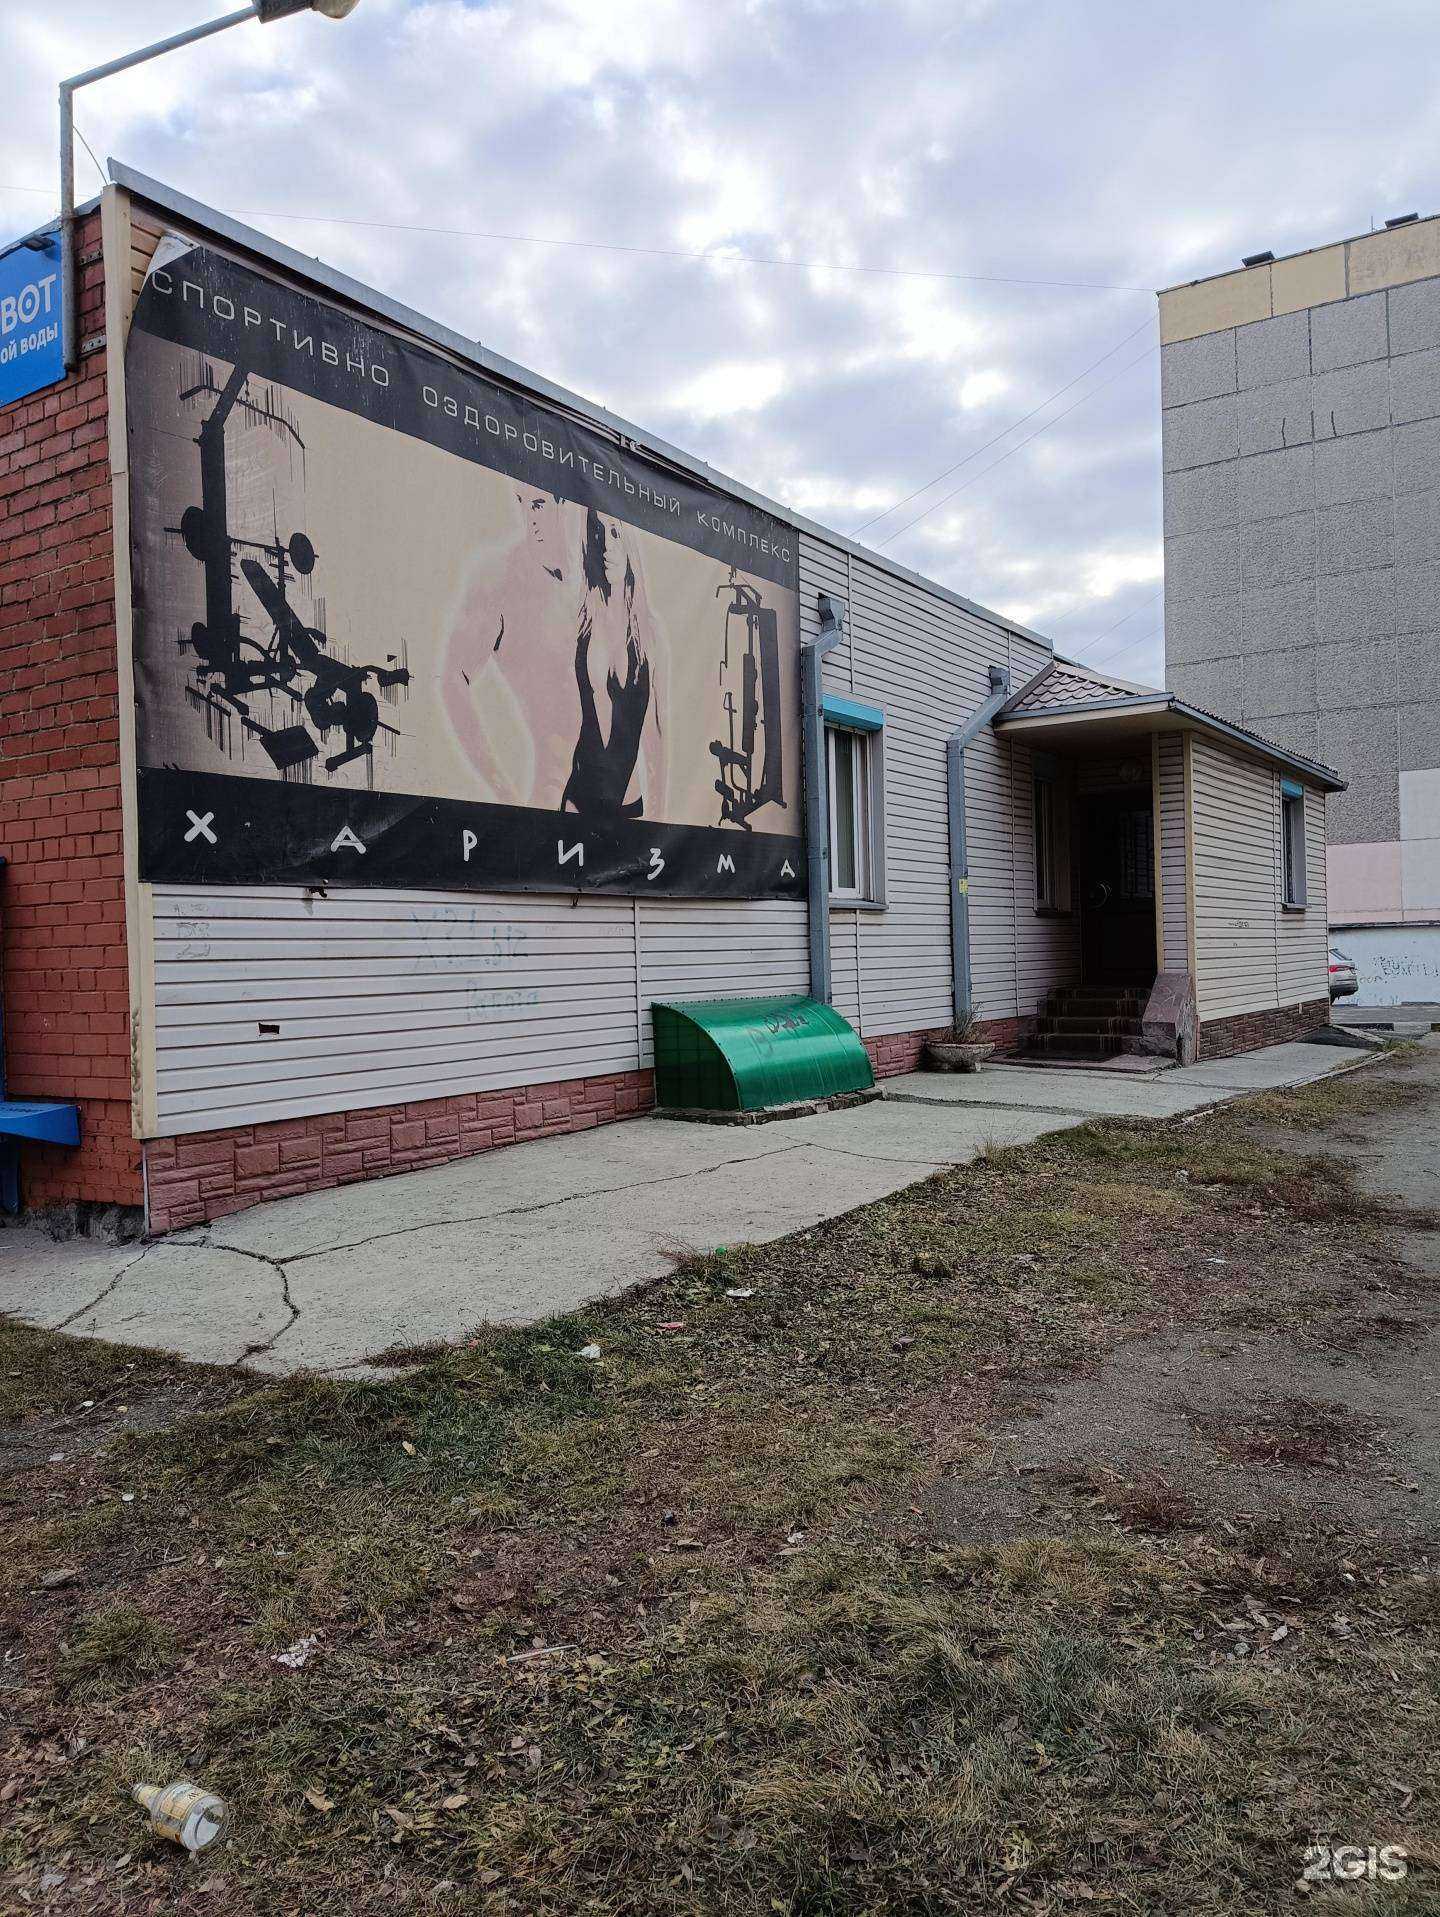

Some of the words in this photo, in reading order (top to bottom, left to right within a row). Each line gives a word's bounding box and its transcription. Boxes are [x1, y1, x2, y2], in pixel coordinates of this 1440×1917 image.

[152, 270, 390, 387] СПОРТИВНО
[422, 385, 681, 516] ОЗДОРОВИТЕЛЬНЫЙ
[696, 510, 792, 563] КОМПЛЕКС
[184, 810, 796, 880] ХАРИЗМА
